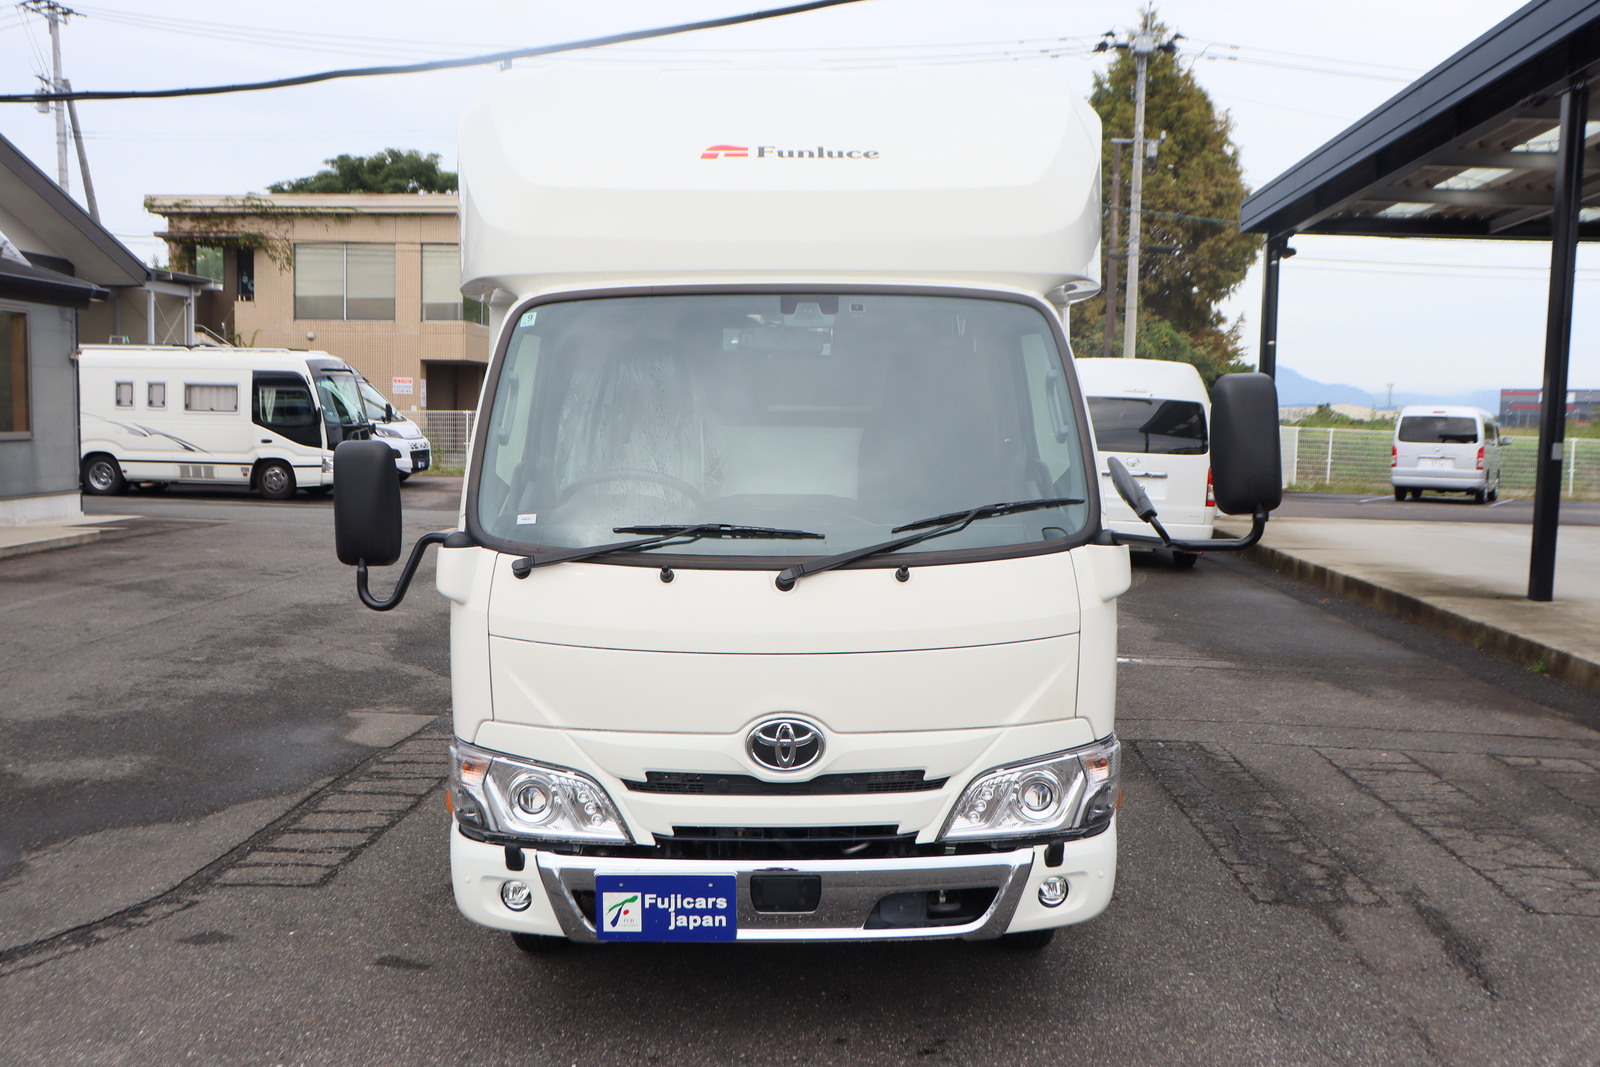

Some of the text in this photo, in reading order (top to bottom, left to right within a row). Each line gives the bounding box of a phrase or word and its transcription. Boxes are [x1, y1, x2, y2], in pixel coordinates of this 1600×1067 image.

[756, 146, 880, 159] Funluce
[644, 894, 728, 912] Fujicars
[668, 911, 727, 930] japan
